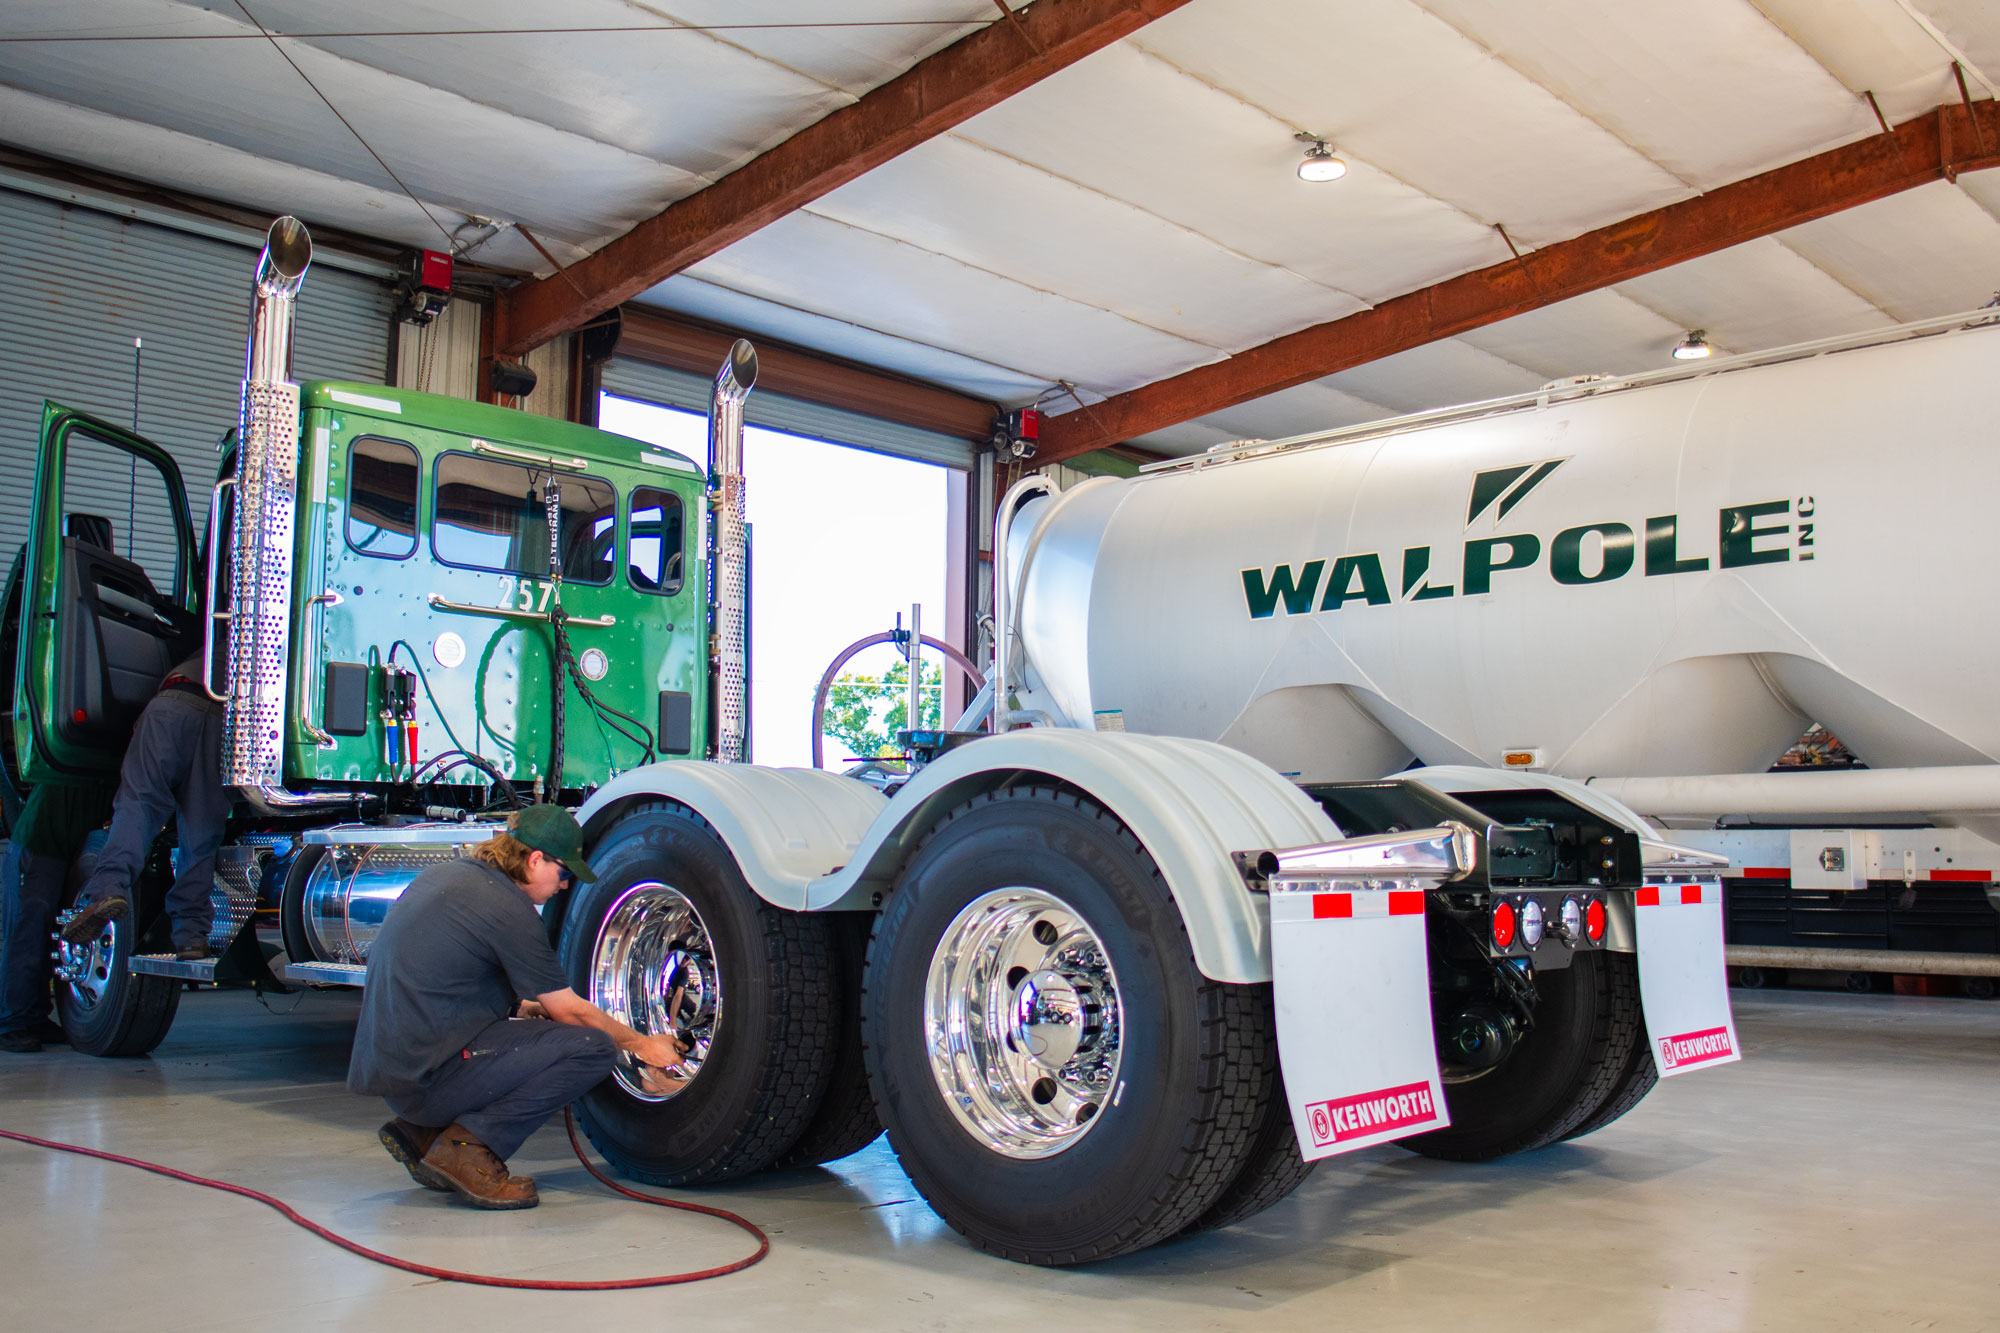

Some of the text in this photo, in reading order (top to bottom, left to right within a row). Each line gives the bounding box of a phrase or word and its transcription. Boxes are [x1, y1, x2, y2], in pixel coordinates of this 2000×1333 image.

[1797, 495, 1815, 562] INC
[1240, 499, 1790, 619] WALPOLE
[498, 576, 553, 612] 257
[1673, 1032, 1730, 1061] KENWORTH
[1331, 1089, 1432, 1134] KENWORTH
